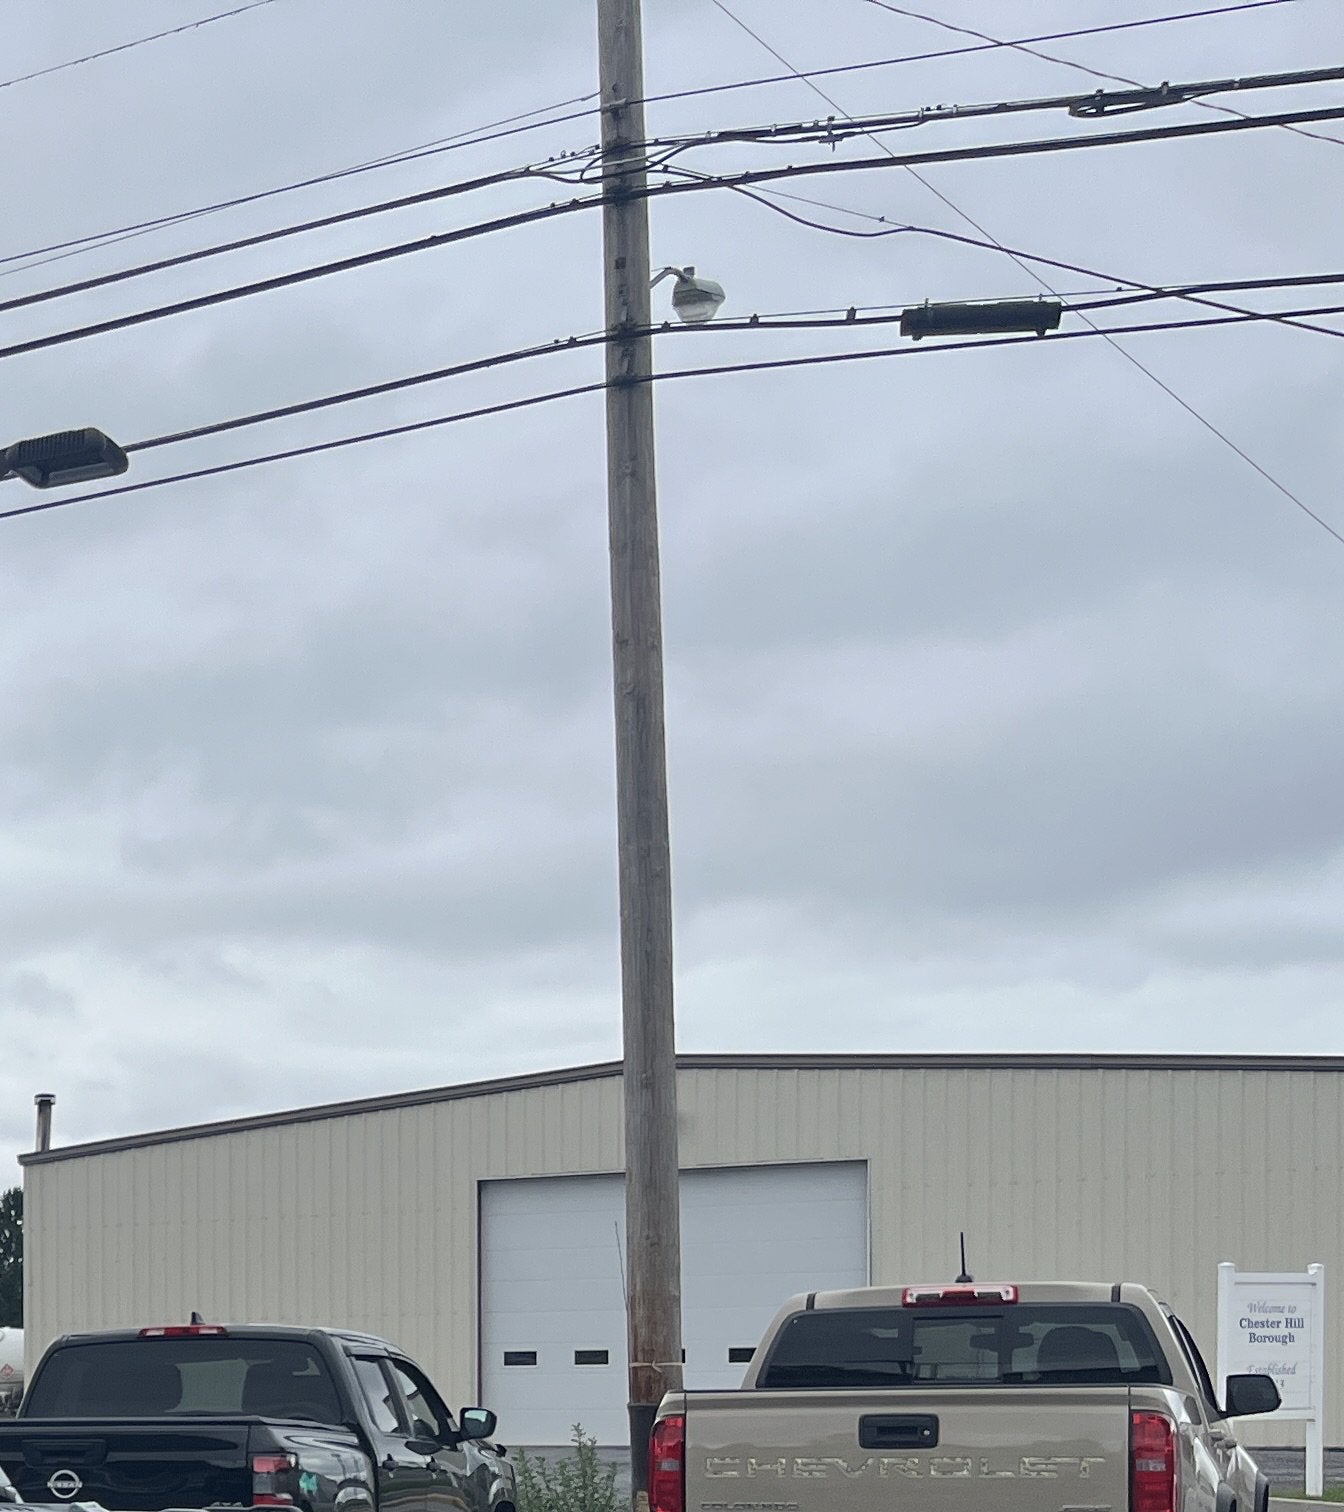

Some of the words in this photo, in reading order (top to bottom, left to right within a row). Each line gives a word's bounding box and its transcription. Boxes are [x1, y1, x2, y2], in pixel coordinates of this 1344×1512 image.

[1247, 1301, 1285, 1314] Welcome
[1287, 1304, 1297, 1314] to
[1239, 1317, 1282, 1329] Chester
[1284, 1317, 1305, 1329] Hill
[1248, 1332, 1295, 1345] Borough
[704, 1457, 1106, 1479] CHEVROLET
